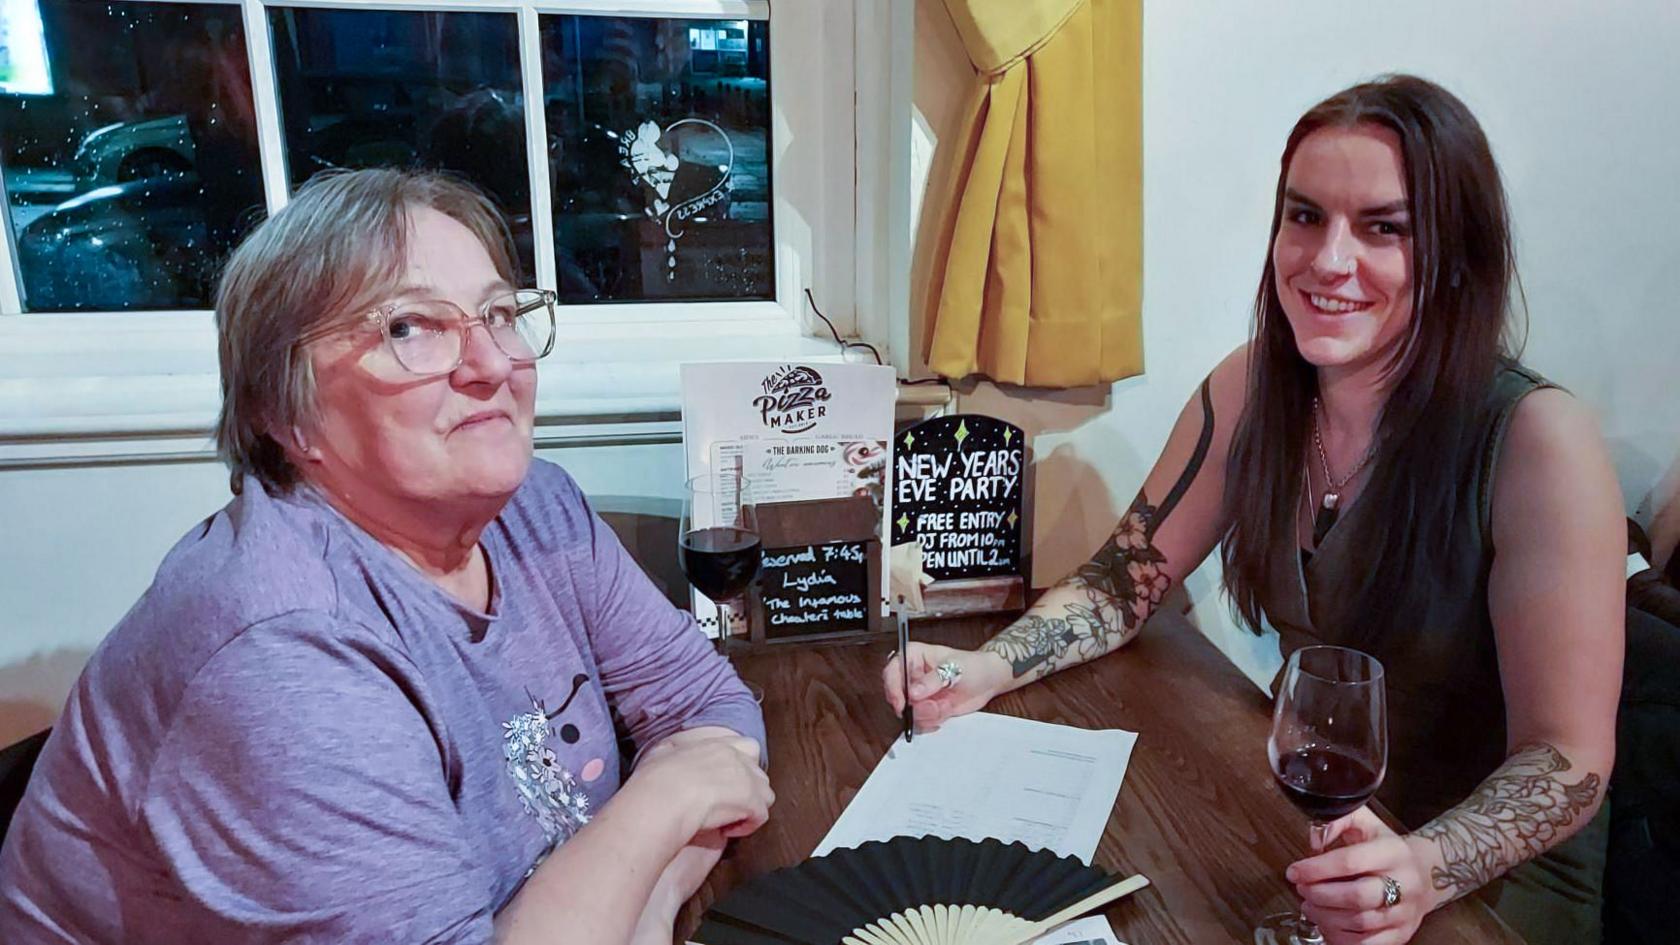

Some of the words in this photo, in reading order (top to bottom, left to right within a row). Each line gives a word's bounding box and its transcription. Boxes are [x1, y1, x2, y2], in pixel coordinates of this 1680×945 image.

[761, 374, 778, 395] The
[752, 386, 832, 427] Pizza
[770, 405, 827, 429] MAKER
[773, 446, 785, 456] THE
[786, 445, 815, 456] BARKING
[815, 444, 830, 455] DOG
[898, 452, 954, 480] NEW
[960, 449, 1022, 478] YEARS
[898, 478, 937, 503] EVE
[949, 475, 1018, 501] PARTY
[916, 512, 954, 532] FREE
[959, 510, 1006, 530] ENTRY
[916, 532, 937, 550] DJ
[939, 532, 980, 549] FROM
[760, 545, 817, 568] eserved
[921, 551, 946, 569] PEN
[947, 549, 986, 568] UNTIL
[782, 569, 837, 592] Lydia
